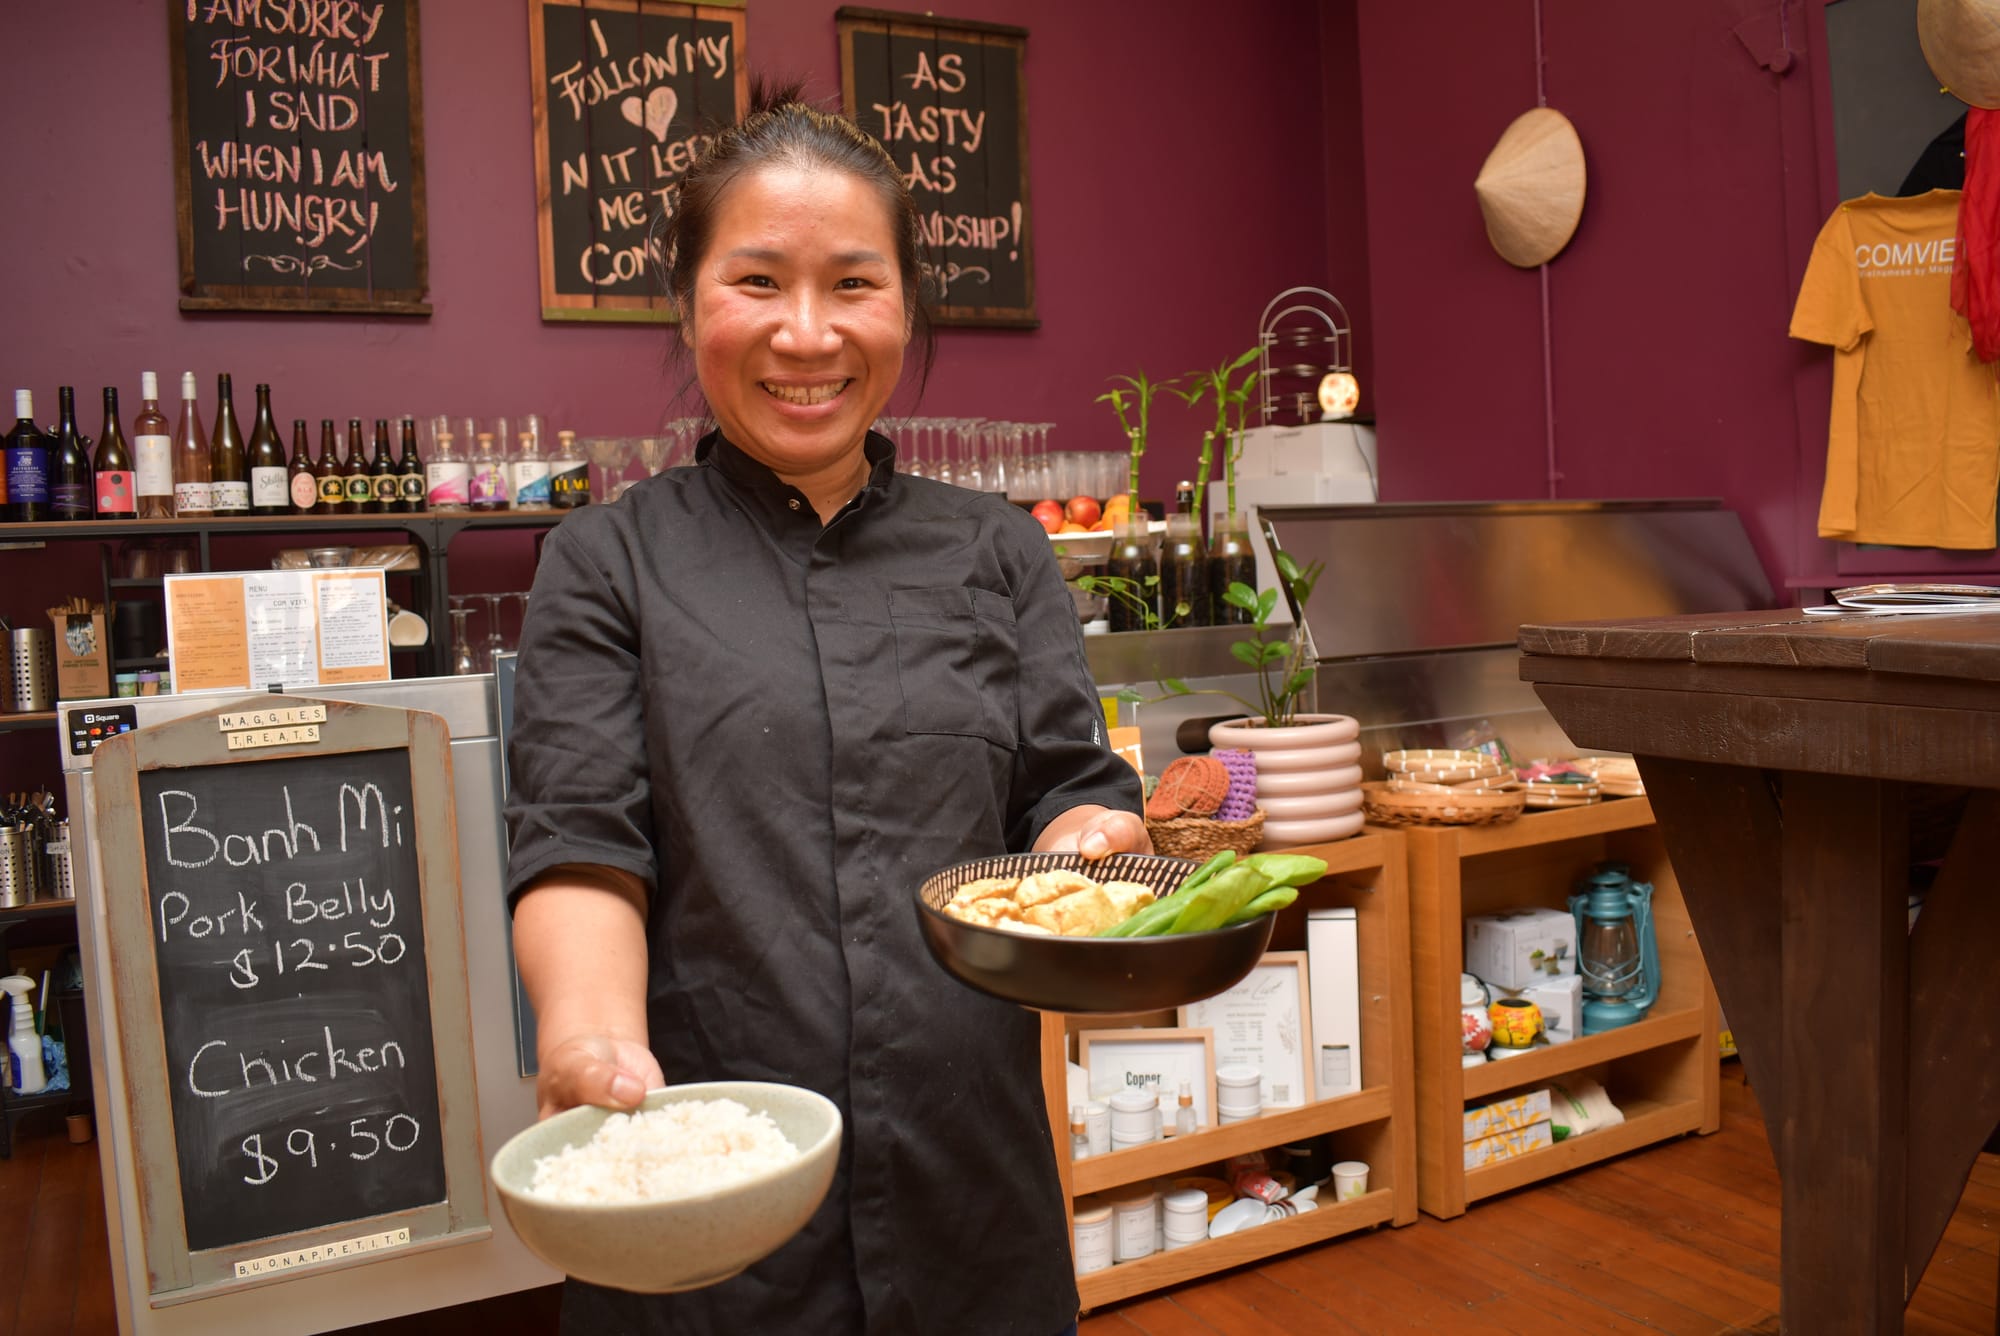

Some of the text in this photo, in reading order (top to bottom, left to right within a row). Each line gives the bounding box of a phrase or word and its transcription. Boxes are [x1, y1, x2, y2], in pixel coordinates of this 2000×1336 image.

[203, 0, 263, 29] AM
[264, 0, 385, 48] SORRY
[590, 18, 609, 58] I
[210, 35, 390, 92] FOR WHAT
[551, 33, 730, 121] FOLLOW MY
[901, 51, 967, 93] AS
[246, 90, 359, 132] I SAID
[872, 101, 986, 154] TASTY
[196, 140, 398, 193] WHEN I AM
[562, 152, 589, 196] N
[601, 146, 638, 185] IT
[904, 152, 958, 194] AS
[215, 188, 379, 254] HUNGRY
[599, 182, 681, 232] ME T
[1856, 238, 1967, 268] COMVIE
[232, 728, 318, 746] TREATS
[158, 782, 403, 869] Banh Mi
[159, 878, 396, 944] Pork Belly
[188, 1025, 406, 1098] Chicken
